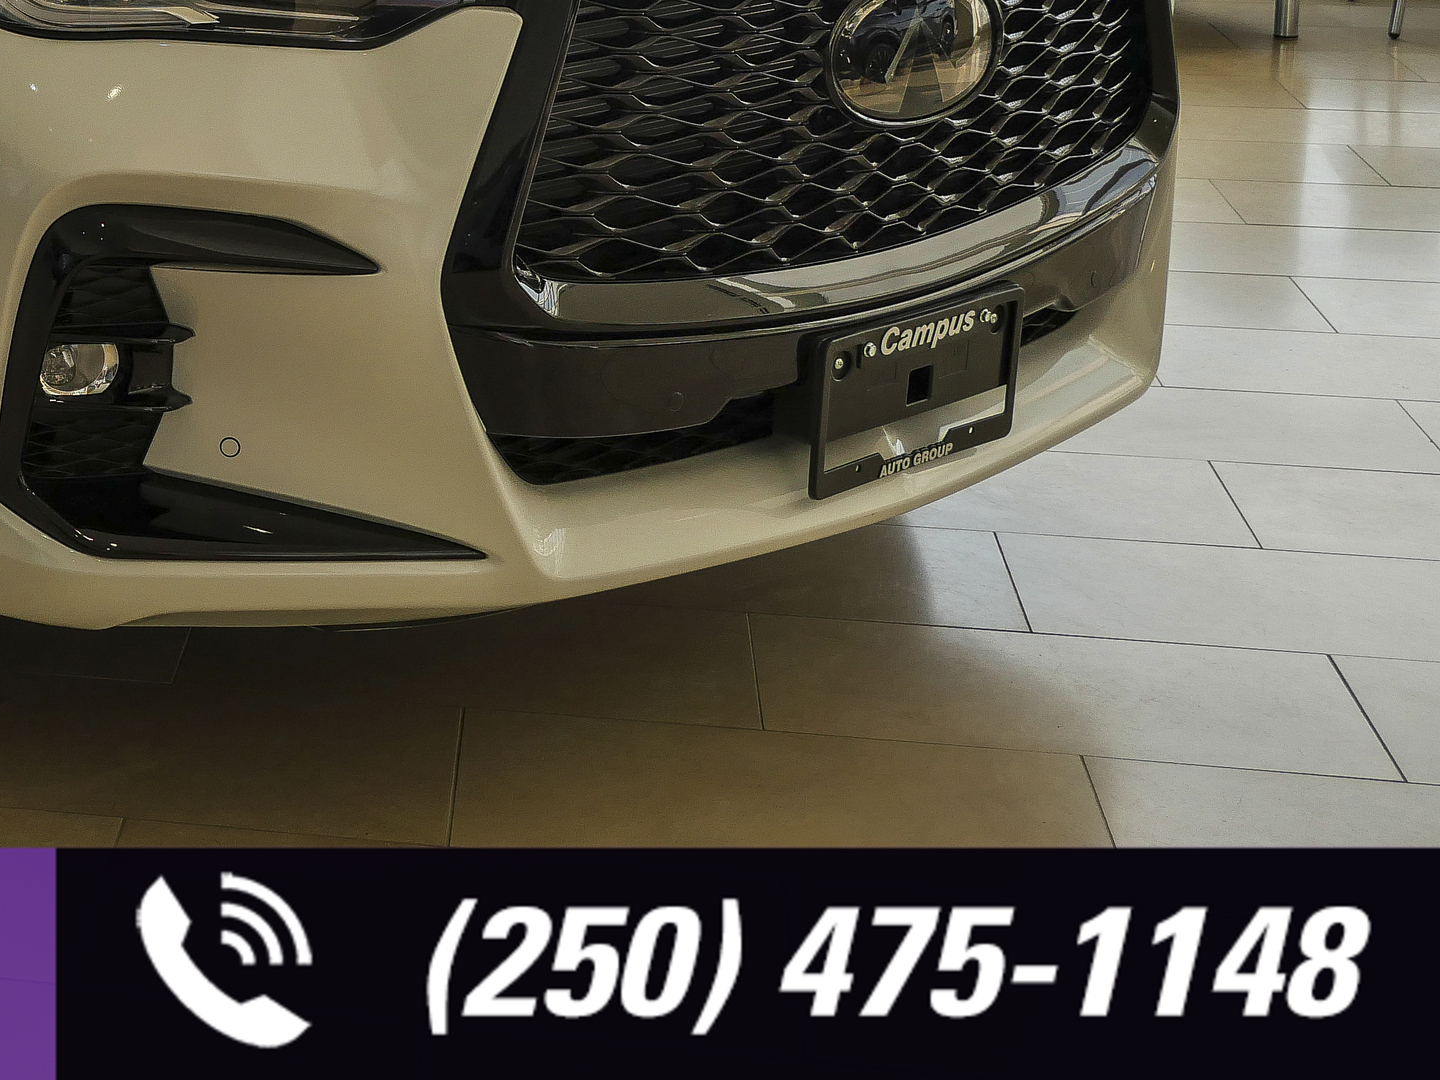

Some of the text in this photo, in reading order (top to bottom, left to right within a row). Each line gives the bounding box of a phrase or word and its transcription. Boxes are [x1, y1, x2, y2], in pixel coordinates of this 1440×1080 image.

[880, 309, 976, 356] Campus
[879, 442, 954, 479] AUTO GROUP
